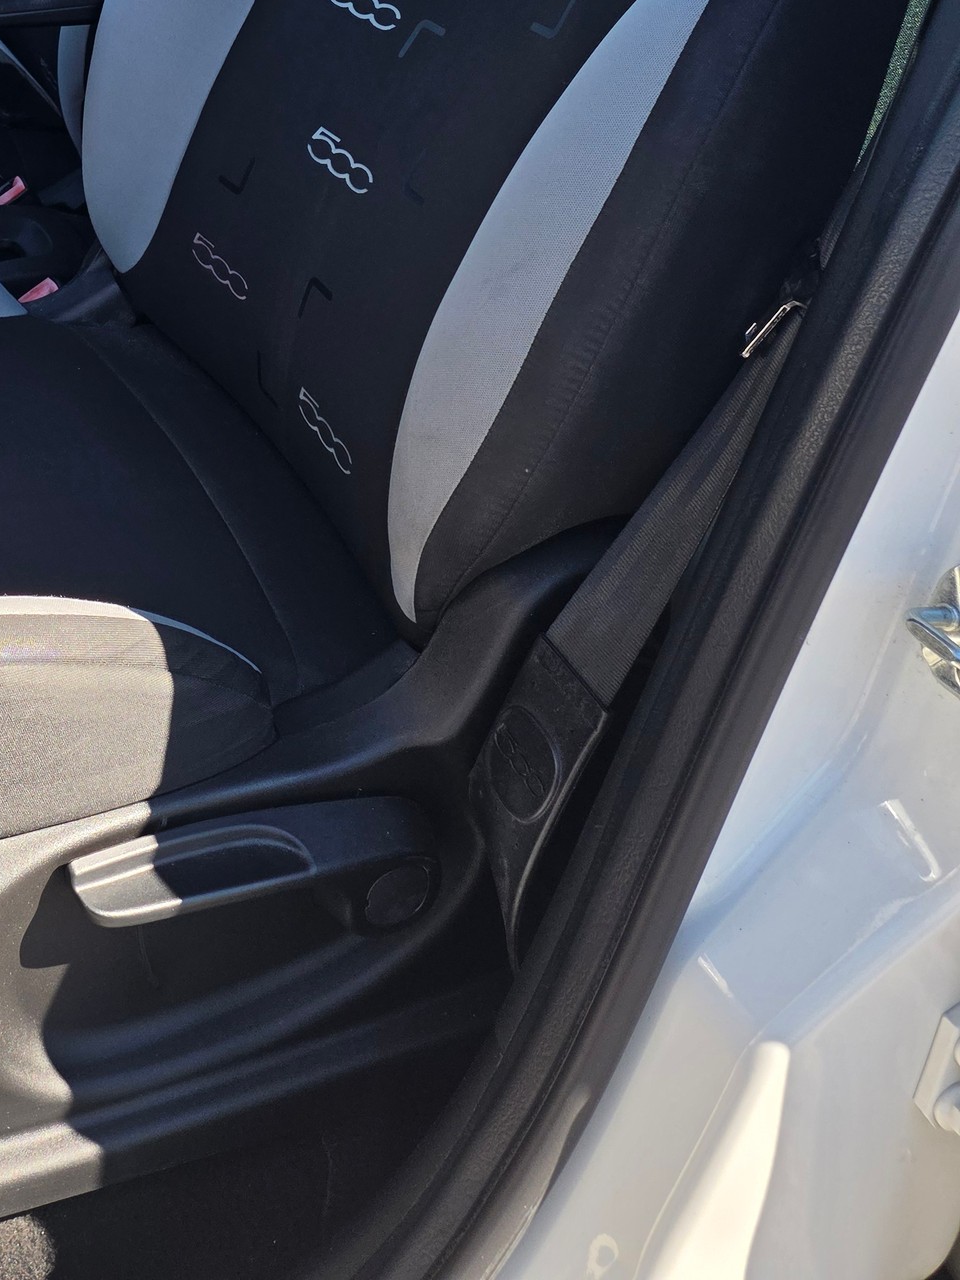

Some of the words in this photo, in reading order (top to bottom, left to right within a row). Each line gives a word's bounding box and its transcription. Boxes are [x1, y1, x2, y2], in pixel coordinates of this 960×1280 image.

[307, 127, 374, 194] 500
[192, 233, 248, 301] 500
[298, 387, 352, 475] 500
